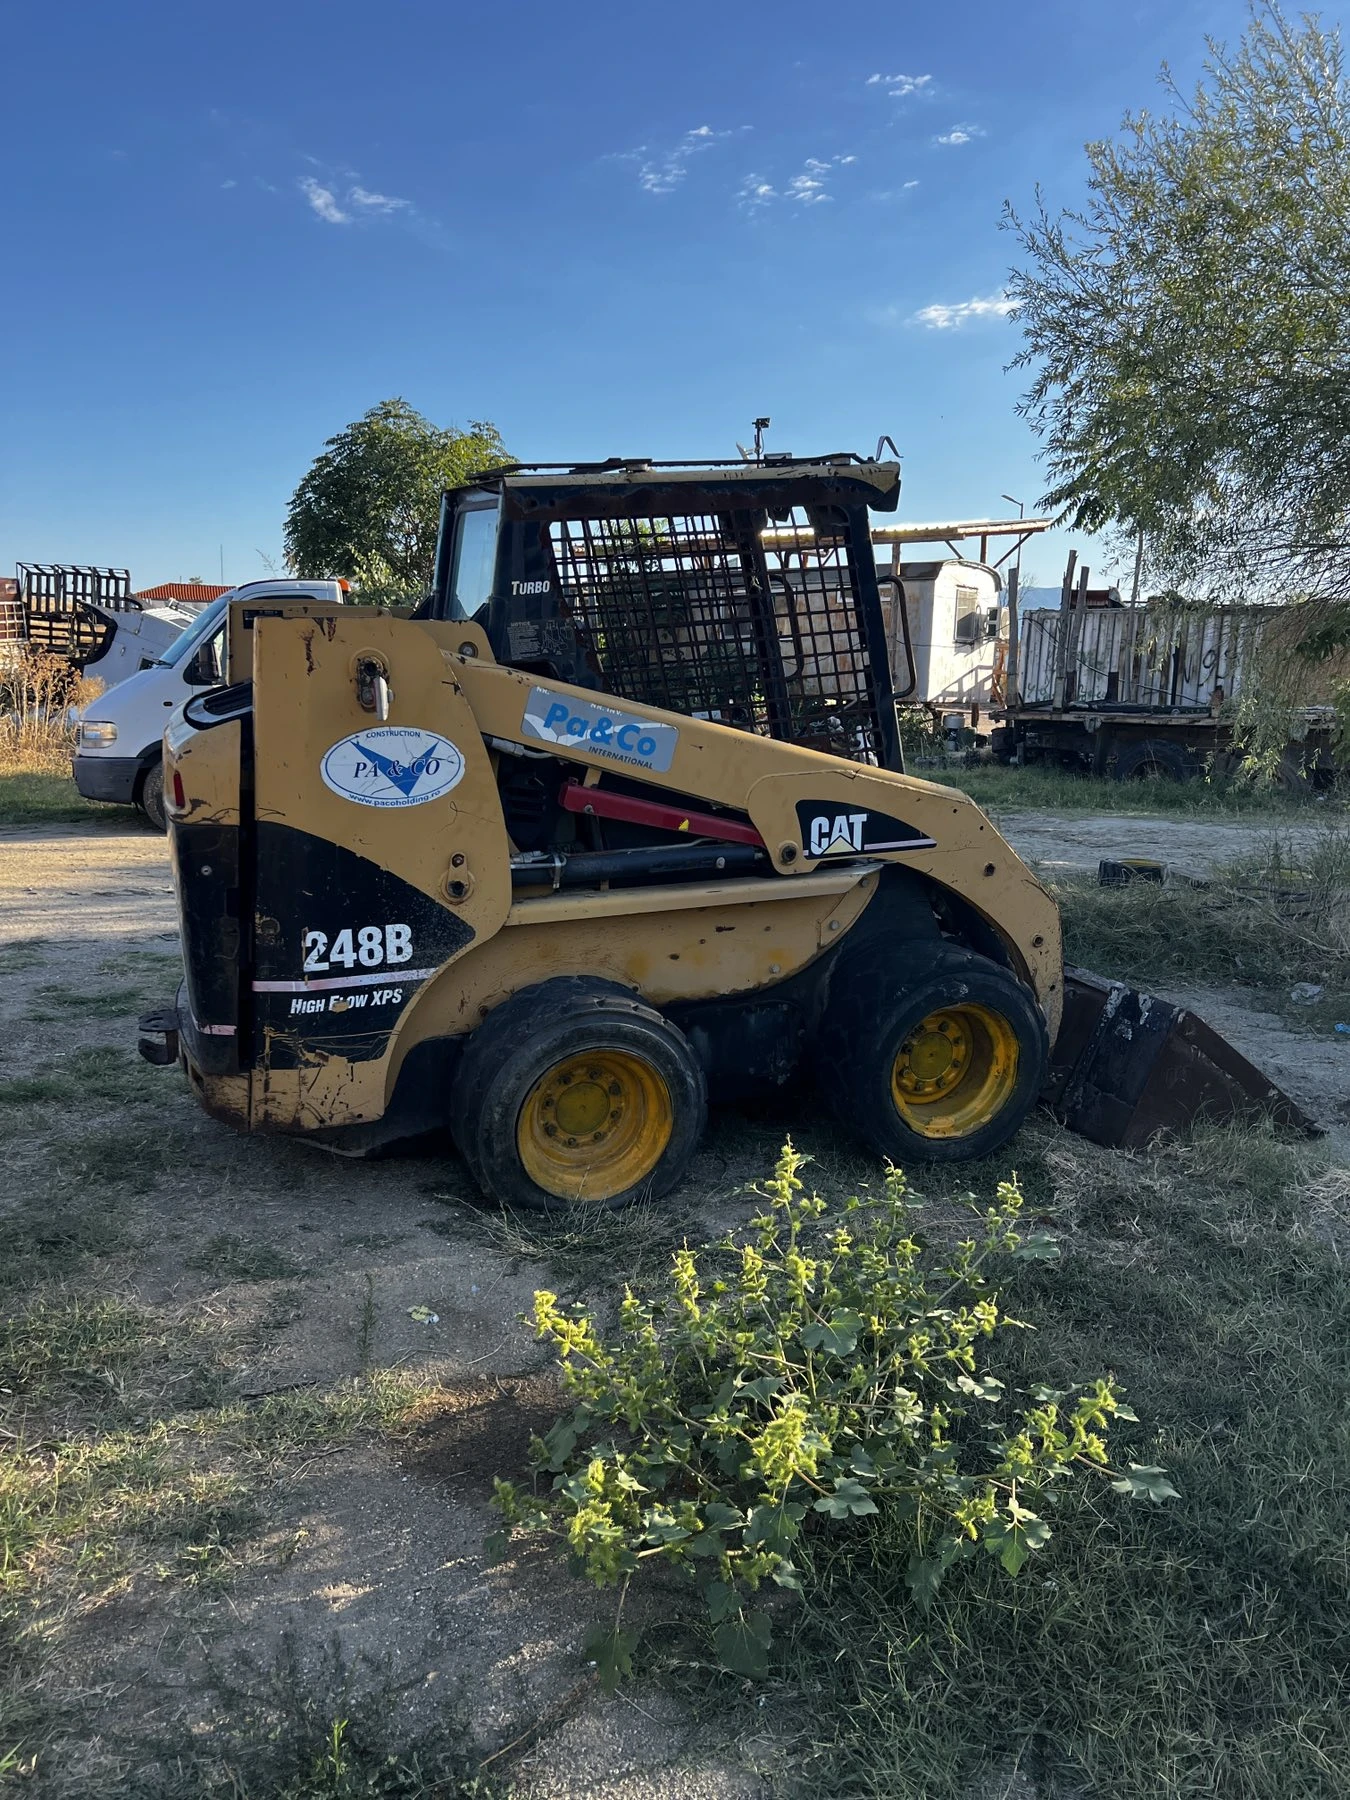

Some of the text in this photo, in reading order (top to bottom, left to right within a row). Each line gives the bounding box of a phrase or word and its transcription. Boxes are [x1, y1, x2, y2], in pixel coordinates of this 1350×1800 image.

[511, 580, 551, 596] TURBO
[366, 730, 421, 739] CONSTRUCTION
[543, 702, 657, 757] Pa&Co
[353, 757, 441, 779] PA & CO
[588, 745, 654, 770] INTERNATIONAL
[348, 790, 442, 808] www.pacoholding.ro
[810, 813, 868, 856] CAT
[302, 923, 414, 973] 248B
[328, 994, 369, 1014] FOW
[370, 988, 404, 1007] XPS
